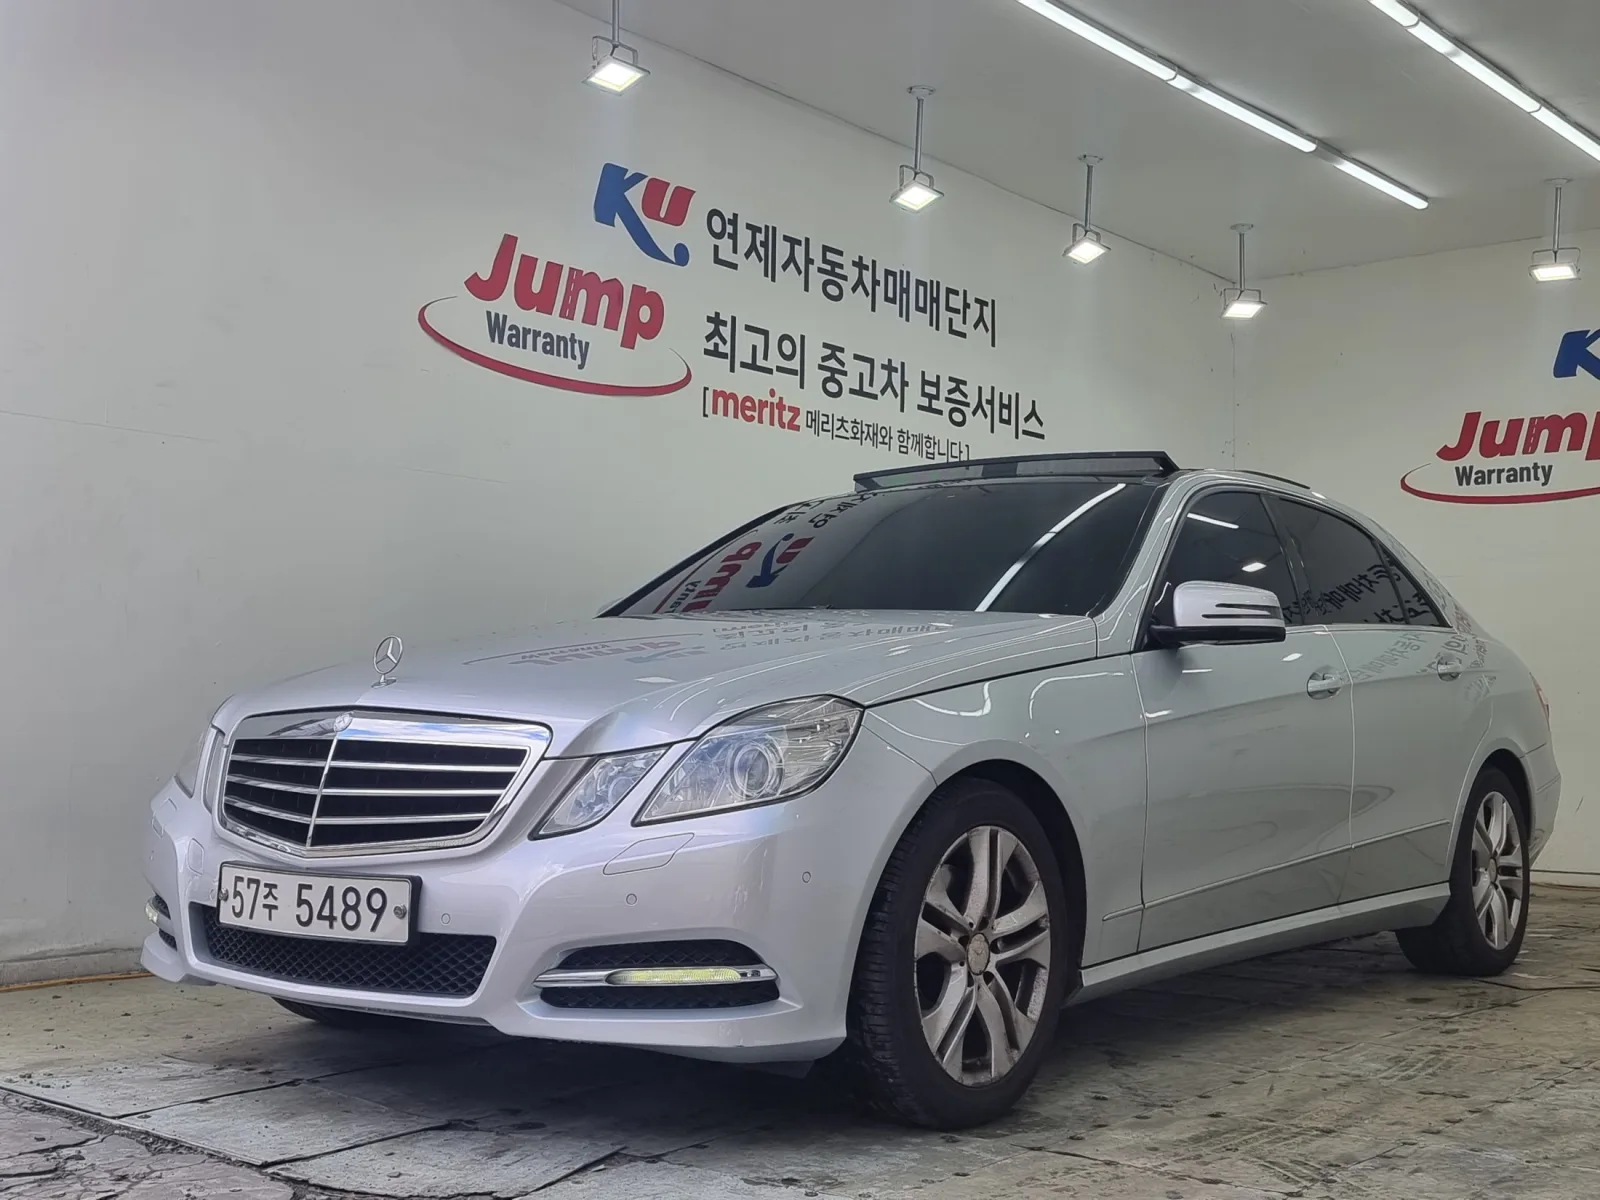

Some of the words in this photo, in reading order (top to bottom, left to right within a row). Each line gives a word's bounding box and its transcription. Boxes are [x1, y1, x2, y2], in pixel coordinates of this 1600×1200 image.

[464, 233, 665, 350] Jump
[706, 208, 995, 348] 연제자동차매매단지
[486, 310, 590, 370] Warranty
[703, 311, 805, 390] 최고의
[817, 342, 909, 413] 중고차
[917, 370, 1045, 440] 보증서비스
[805, 409, 893, 452] 메리츠화재와
[1455, 462, 1553, 487] Warranty
[231, 875, 279, 922] 57주
[295, 883, 388, 933] 5489
